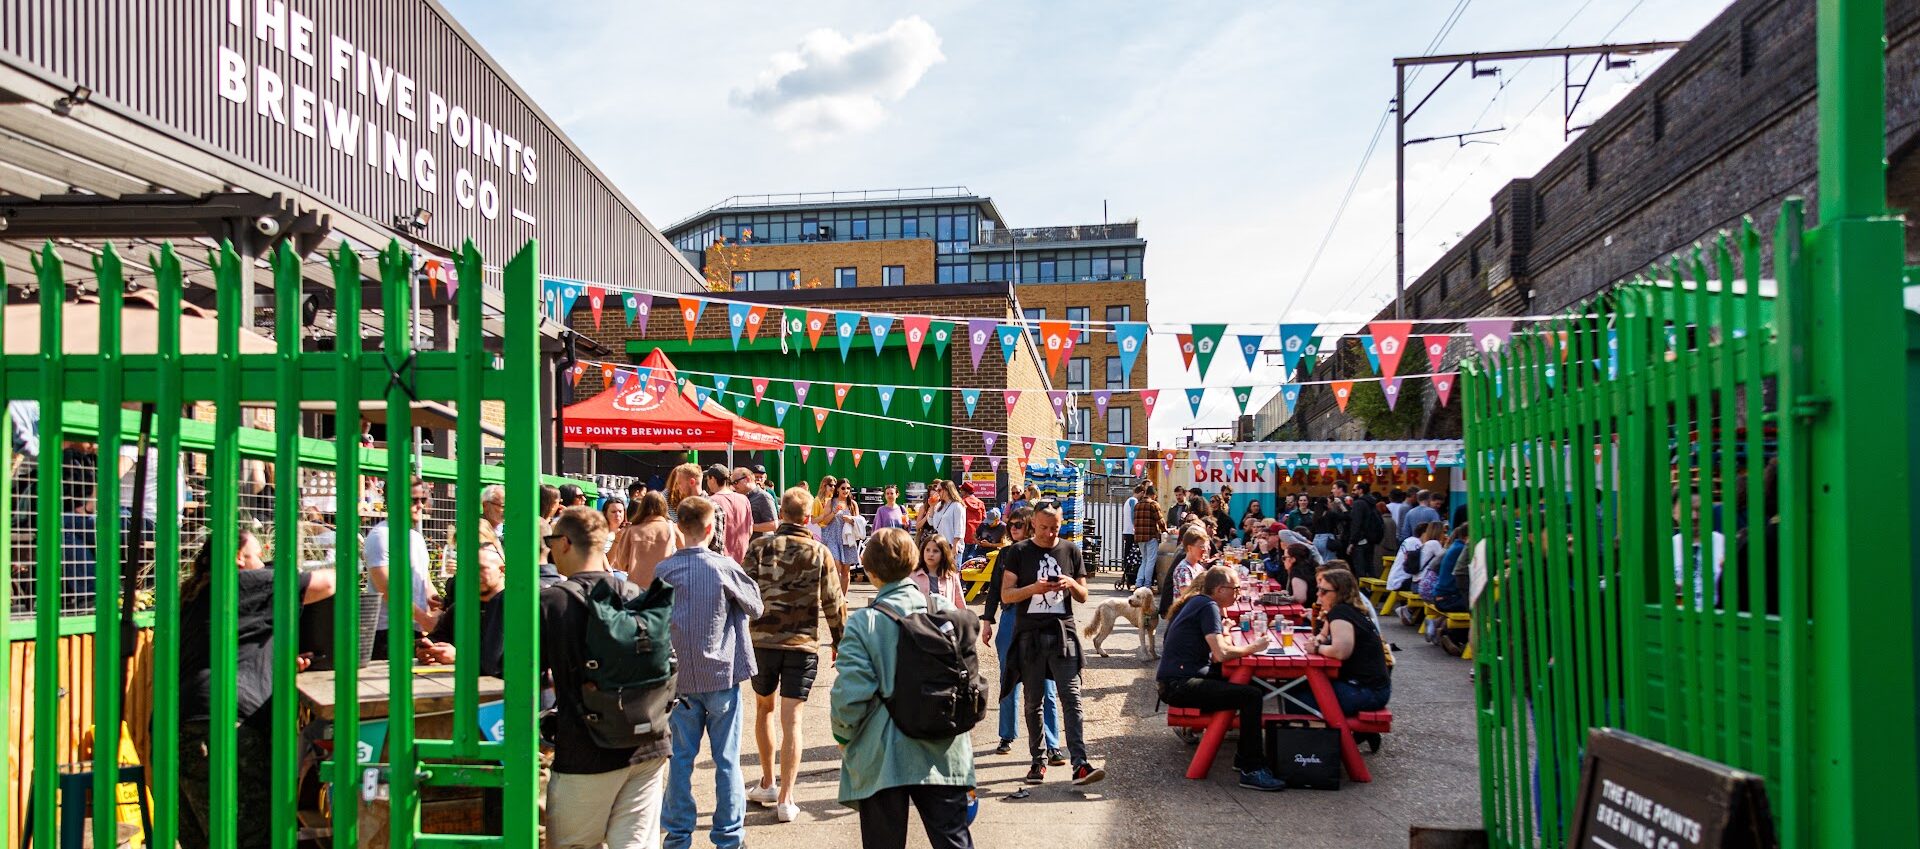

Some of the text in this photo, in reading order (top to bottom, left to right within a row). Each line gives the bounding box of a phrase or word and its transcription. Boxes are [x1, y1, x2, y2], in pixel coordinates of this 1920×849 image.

[331, 34, 416, 122] FIVE
[429, 91, 537, 185] POINTS
[219, 45, 499, 220] BREWING CO
[912, 331, 918, 340] 5
[1051, 338, 1057, 348] 5
[1202, 341, 1209, 351] 5
[1290, 339, 1297, 348] 5
[1386, 340, 1393, 351] 5
[564, 426, 702, 436] IVE POINTS BREWING CO
[1195, 469, 1266, 483] DRINK
[1279, 468, 1419, 486] FRESH BEER
[1602, 779, 1701, 844] THE FIVE POINTS
[1597, 803, 1680, 849] BREWING CO
